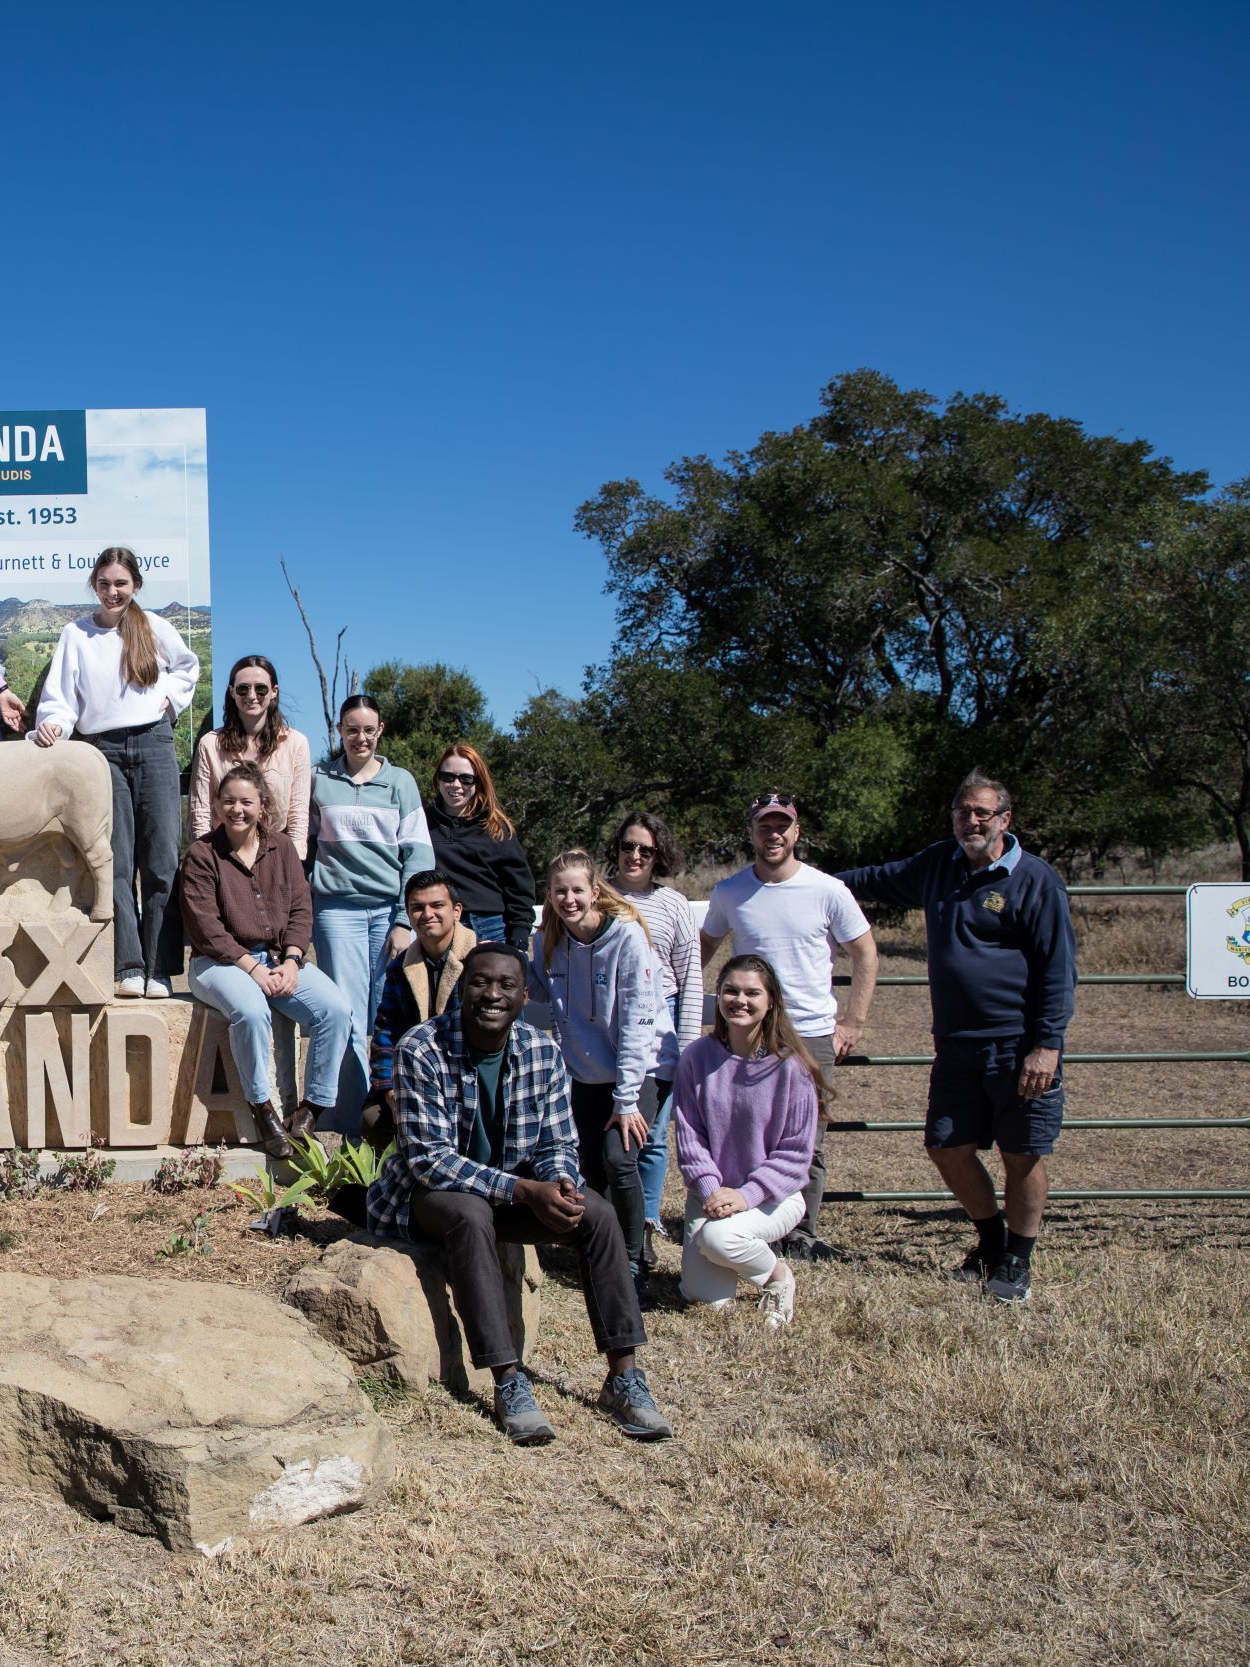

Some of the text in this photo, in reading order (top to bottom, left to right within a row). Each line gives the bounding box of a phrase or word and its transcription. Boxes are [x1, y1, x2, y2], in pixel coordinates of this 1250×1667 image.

[28, 506, 78, 525] 1953
[51, 553, 62, 570] &
[136, 555, 170, 571] oyce
[1228, 976, 1250, 988] BO
